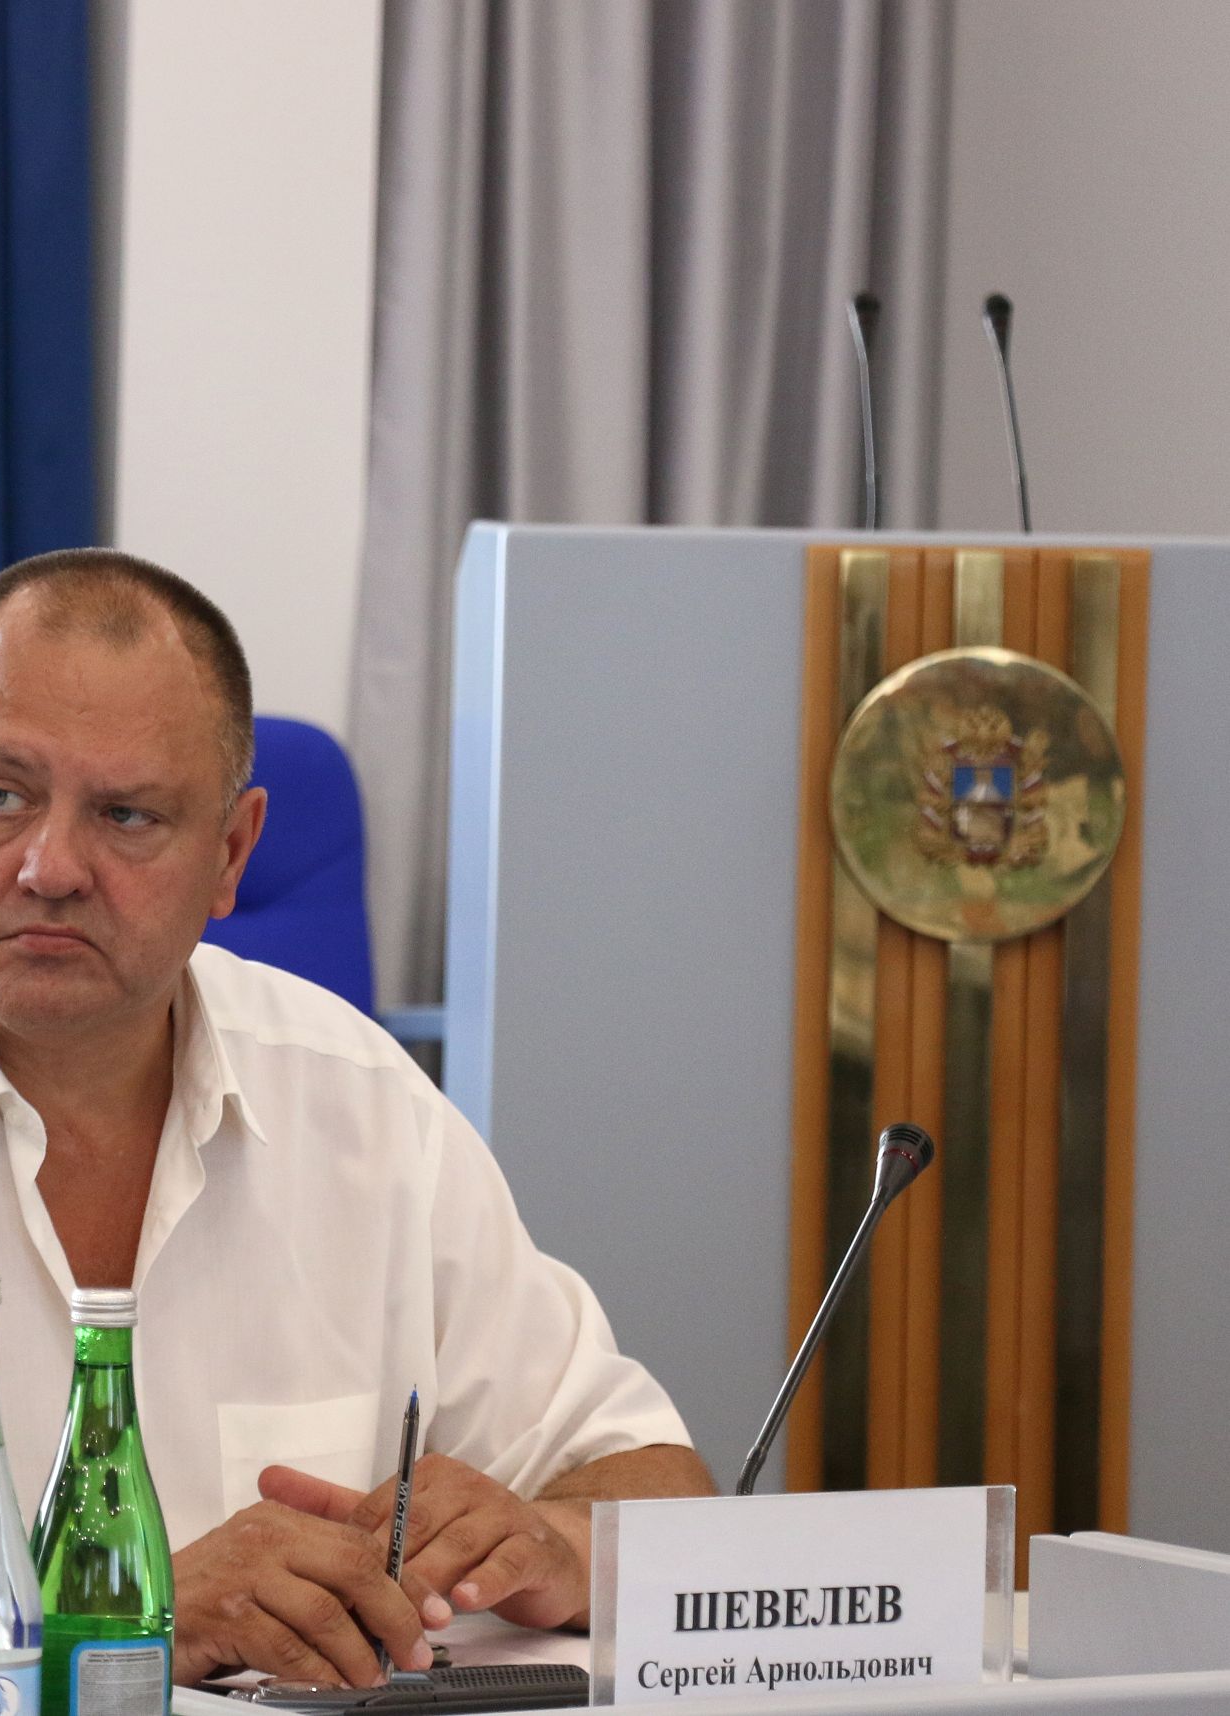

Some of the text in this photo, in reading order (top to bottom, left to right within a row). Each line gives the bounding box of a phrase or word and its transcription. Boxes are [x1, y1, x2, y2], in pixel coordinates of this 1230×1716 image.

[674, 1584, 902, 1632] ШЕВЕЛЕВ
[637, 1656, 932, 1695] Сергей Арнольдович
